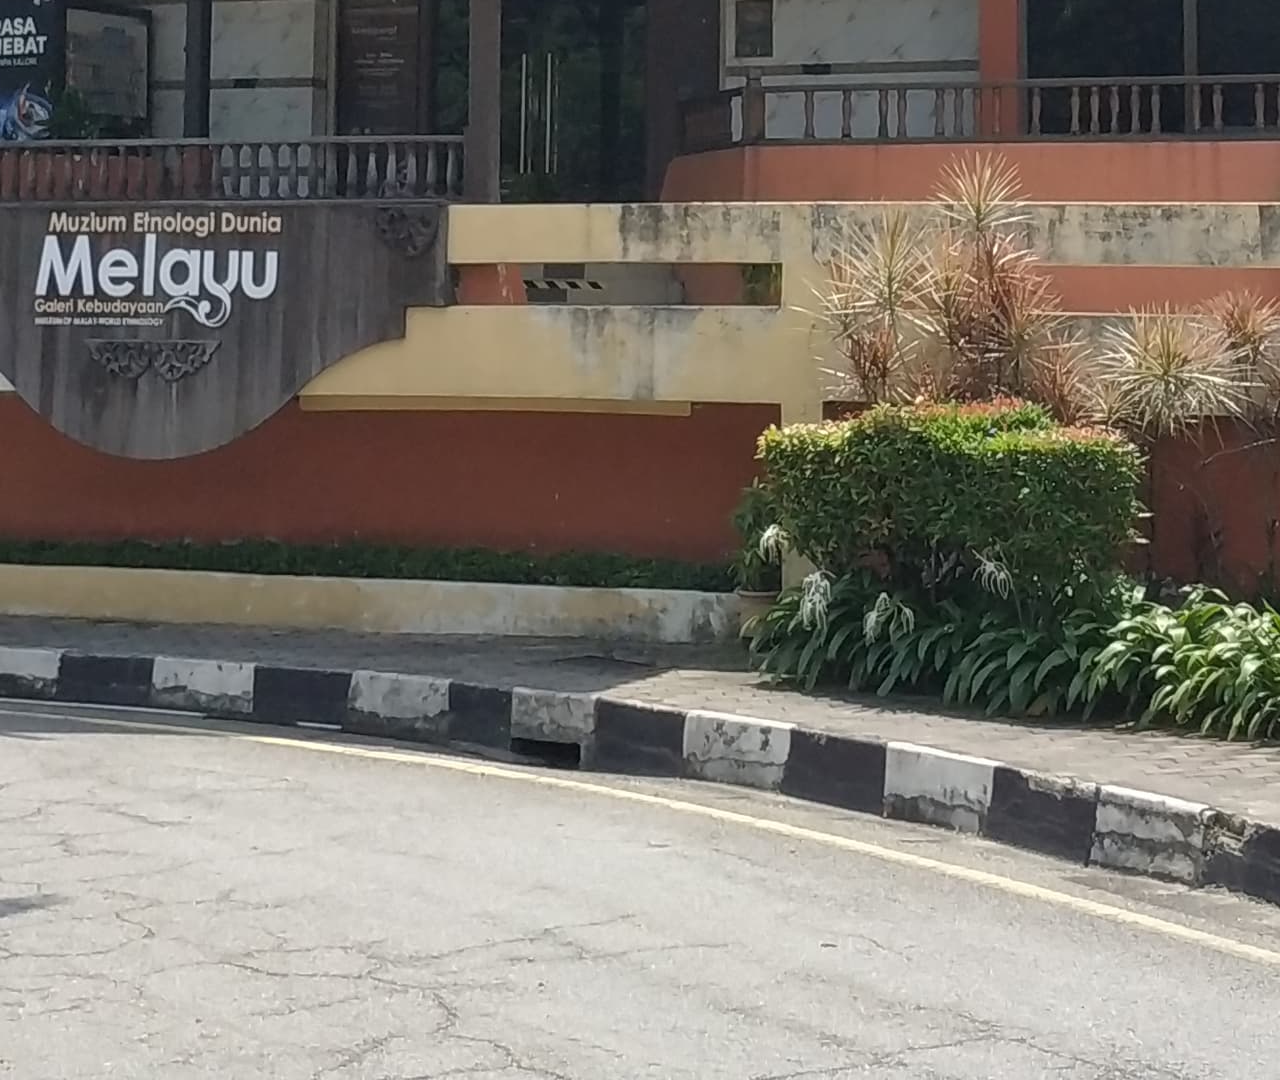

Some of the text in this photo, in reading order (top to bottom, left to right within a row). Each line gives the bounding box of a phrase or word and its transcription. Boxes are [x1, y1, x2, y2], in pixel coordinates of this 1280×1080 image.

[49, 211, 282, 237] Muzium Etnologi Dunia
[35, 233, 279, 328] Melayu
[34, 299, 165, 316] Galeri Kebudayaan
